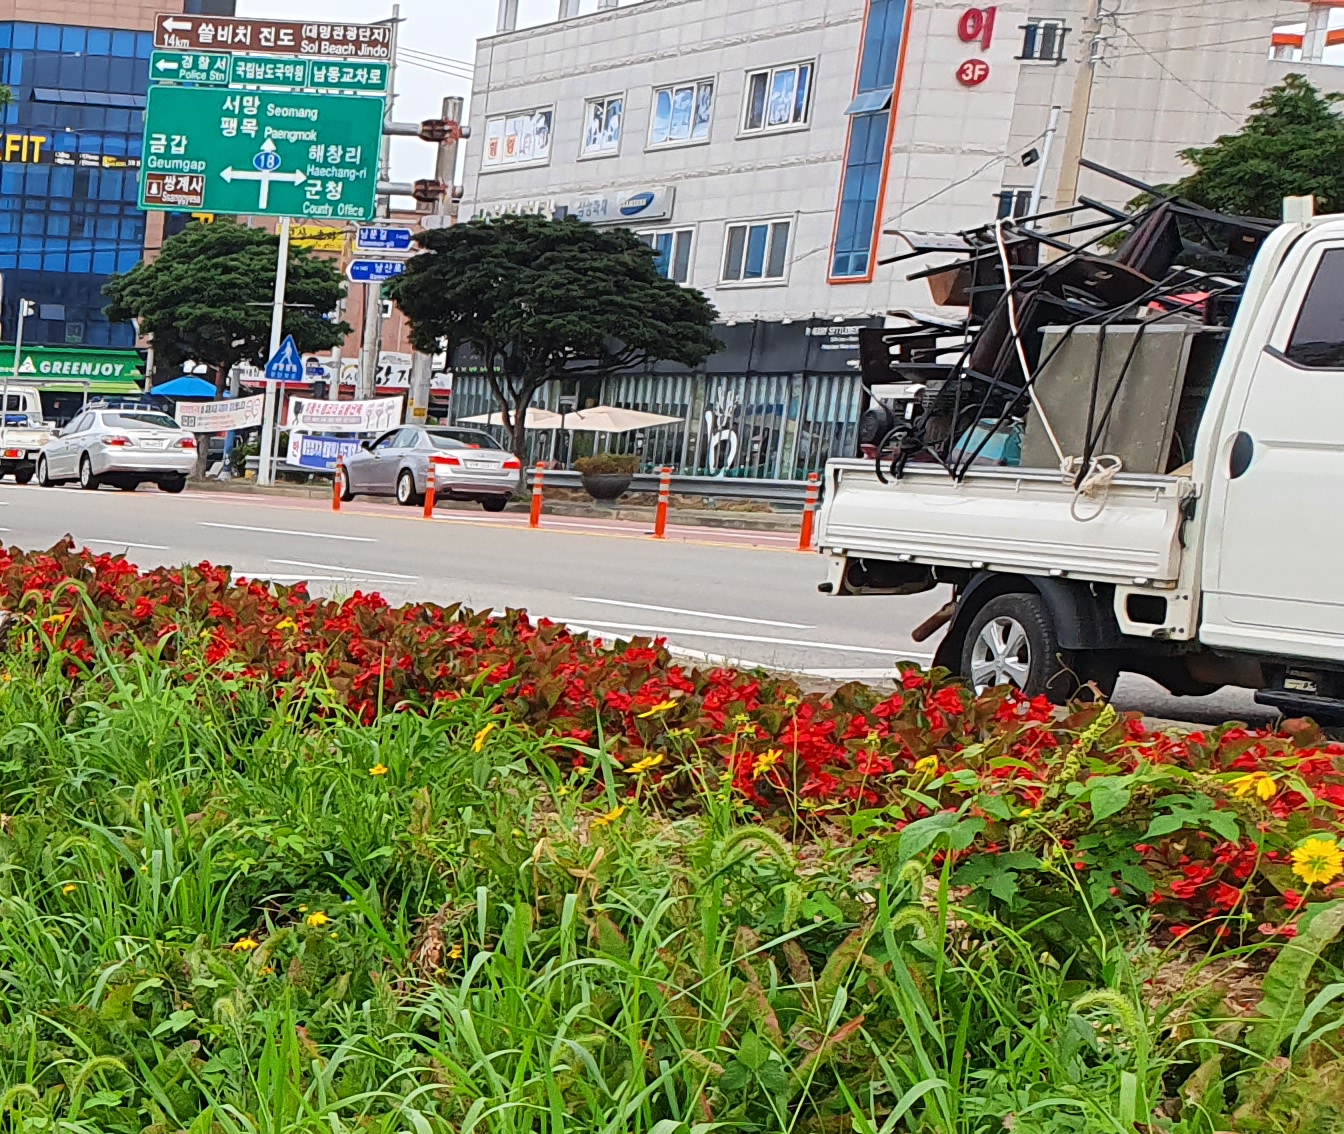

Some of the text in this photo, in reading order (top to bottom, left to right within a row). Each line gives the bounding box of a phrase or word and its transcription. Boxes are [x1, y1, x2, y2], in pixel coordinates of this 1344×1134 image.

[163, 33, 190, 48] 14km
[258, 26, 295, 47] 진도
[301, 24, 390, 43] (대명관광단지)
[300, 40, 388, 57] Sol Beach Jindo
[178, 69, 226, 81] Police Stn
[235, 60, 305, 82] 국립남도국악원
[962, 63, 987, 81] 3F
[222, 95, 261, 115] 서망
[266, 103, 319, 121] Seomang
[219, 117, 259, 138] 팽목
[264, 126, 317, 142] Paengmok
[149, 133, 188, 155] 금갑
[147, 155, 206, 171] Geumgap
[259, 153, 276, 168] 18
[308, 144, 362, 165] 해창리
[306, 164, 367, 181] Haechang-ri
[163, 174, 203, 193] 쌍계사
[304, 179, 343, 201] 군청
[302, 201, 365, 216] County Office
[39, 360, 125, 377] GREENJOY
